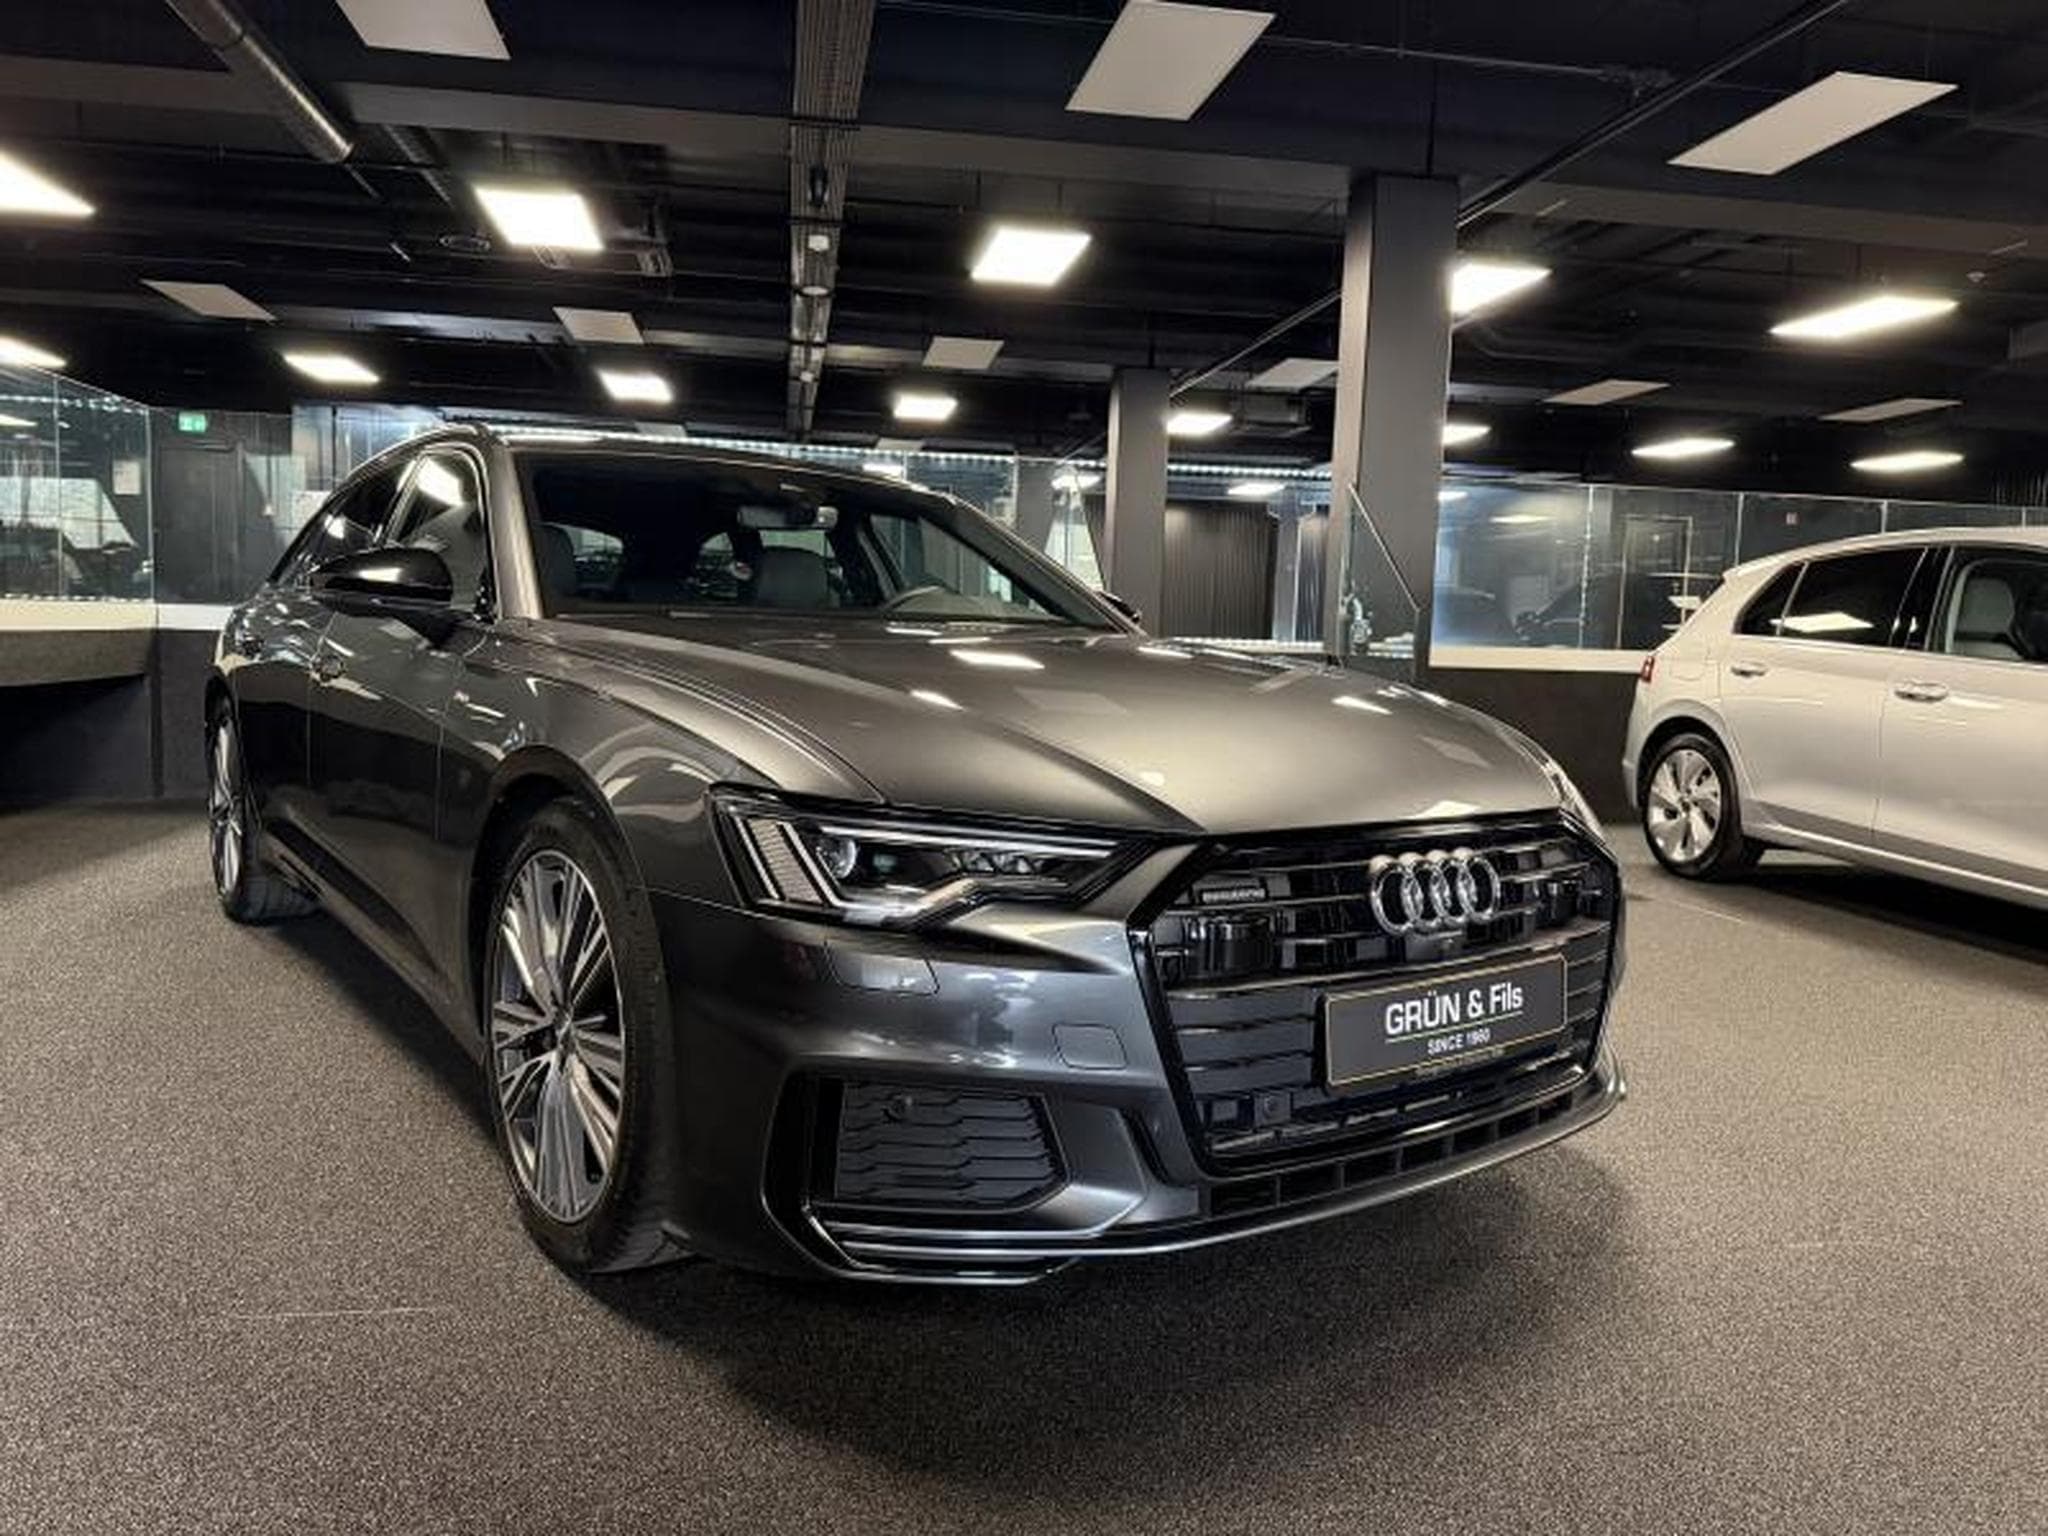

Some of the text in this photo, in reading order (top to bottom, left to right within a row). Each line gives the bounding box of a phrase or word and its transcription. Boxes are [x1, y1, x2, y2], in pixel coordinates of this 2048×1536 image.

[1385, 982, 1523, 1034] GRÜN & Fils
[1427, 1034, 1464, 1055] SINCE
